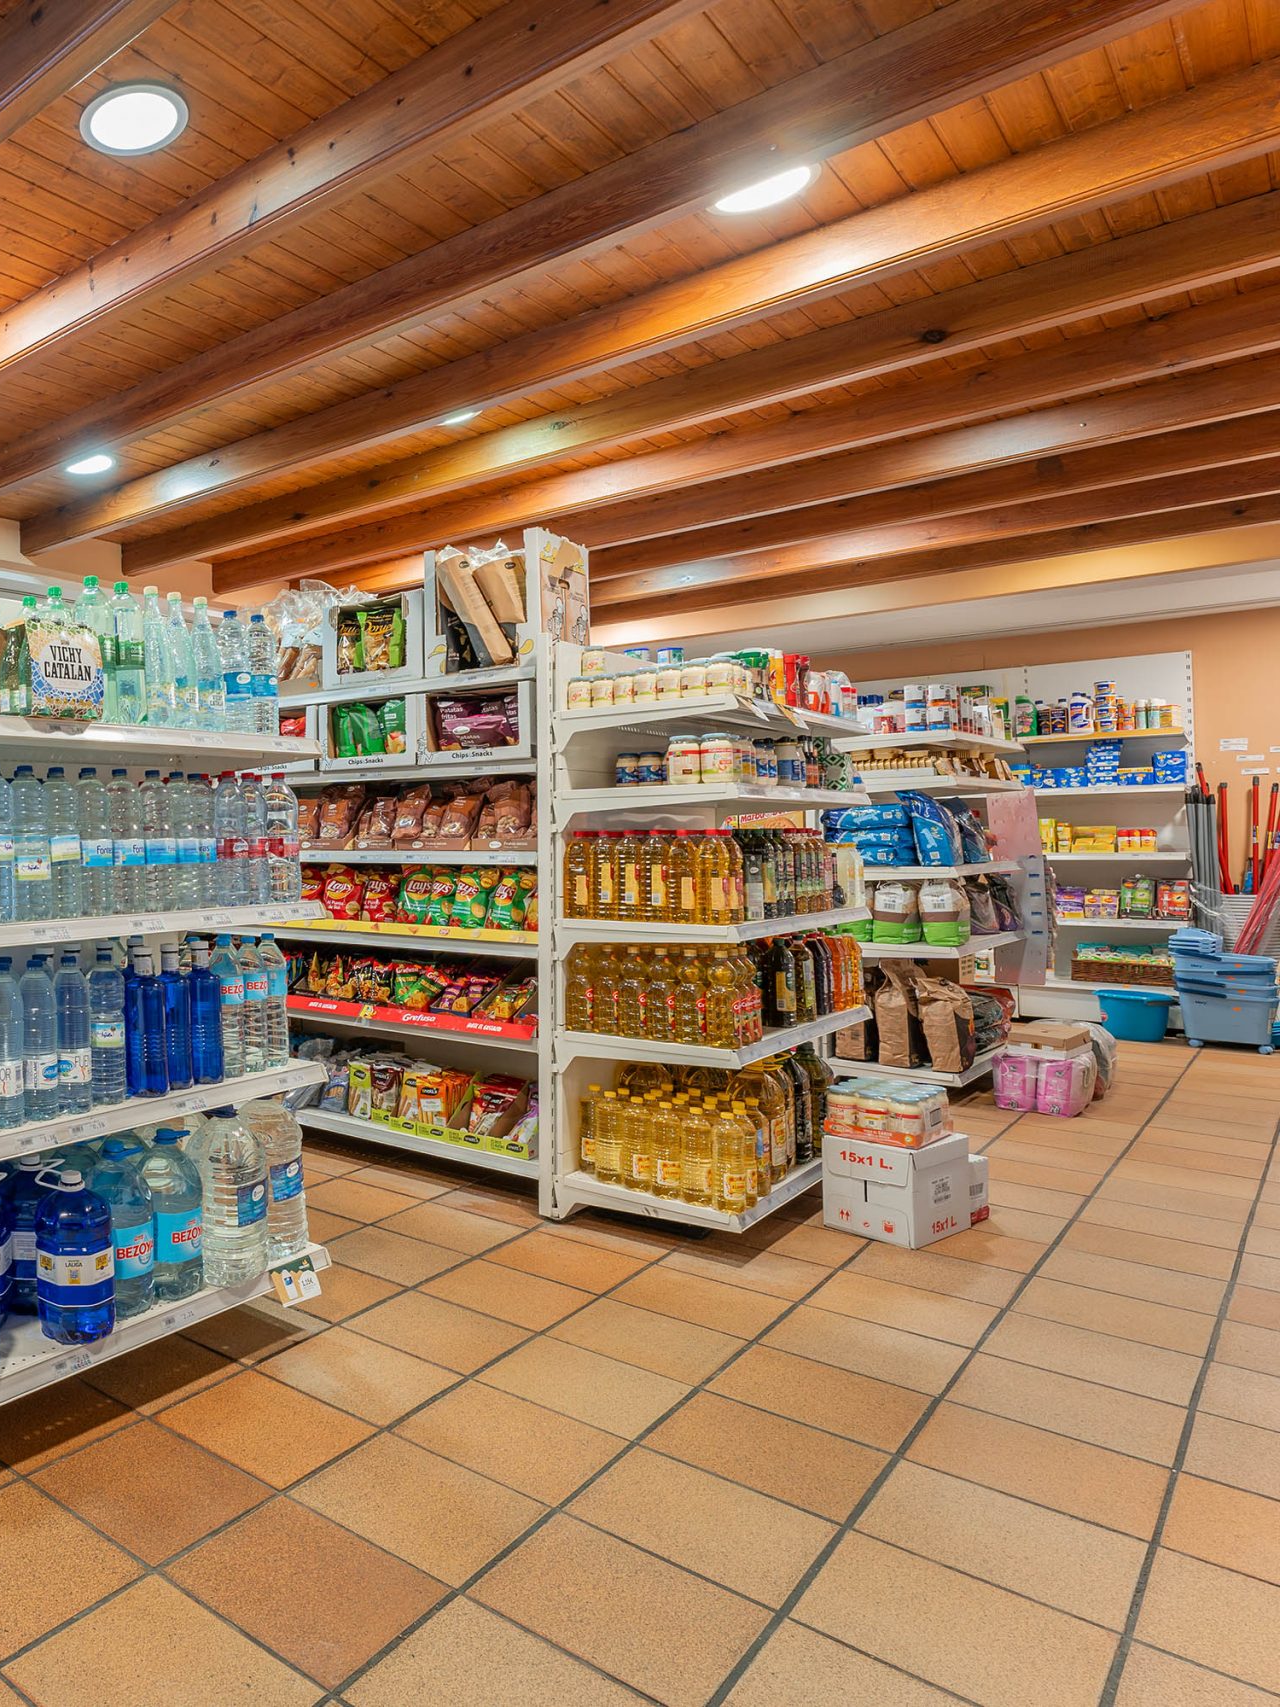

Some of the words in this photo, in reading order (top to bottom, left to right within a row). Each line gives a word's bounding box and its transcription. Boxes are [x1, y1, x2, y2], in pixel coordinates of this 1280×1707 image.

[49, 645, 82, 662] VICHY
[44, 661, 92, 682] CATALAN
[451, 752, 469, 760] Chips
[471, 750, 493, 758] Snacks
[348, 758, 363, 766] Chips
[221, 984, 243, 995] BEZO
[246, 980, 268, 990] BEZO
[402, 1013, 436, 1022] Grefusa
[840, 1150, 873, 1167] 15x1
[879, 1157, 893, 1170] L.
[932, 1216, 949, 1234] 15x1
